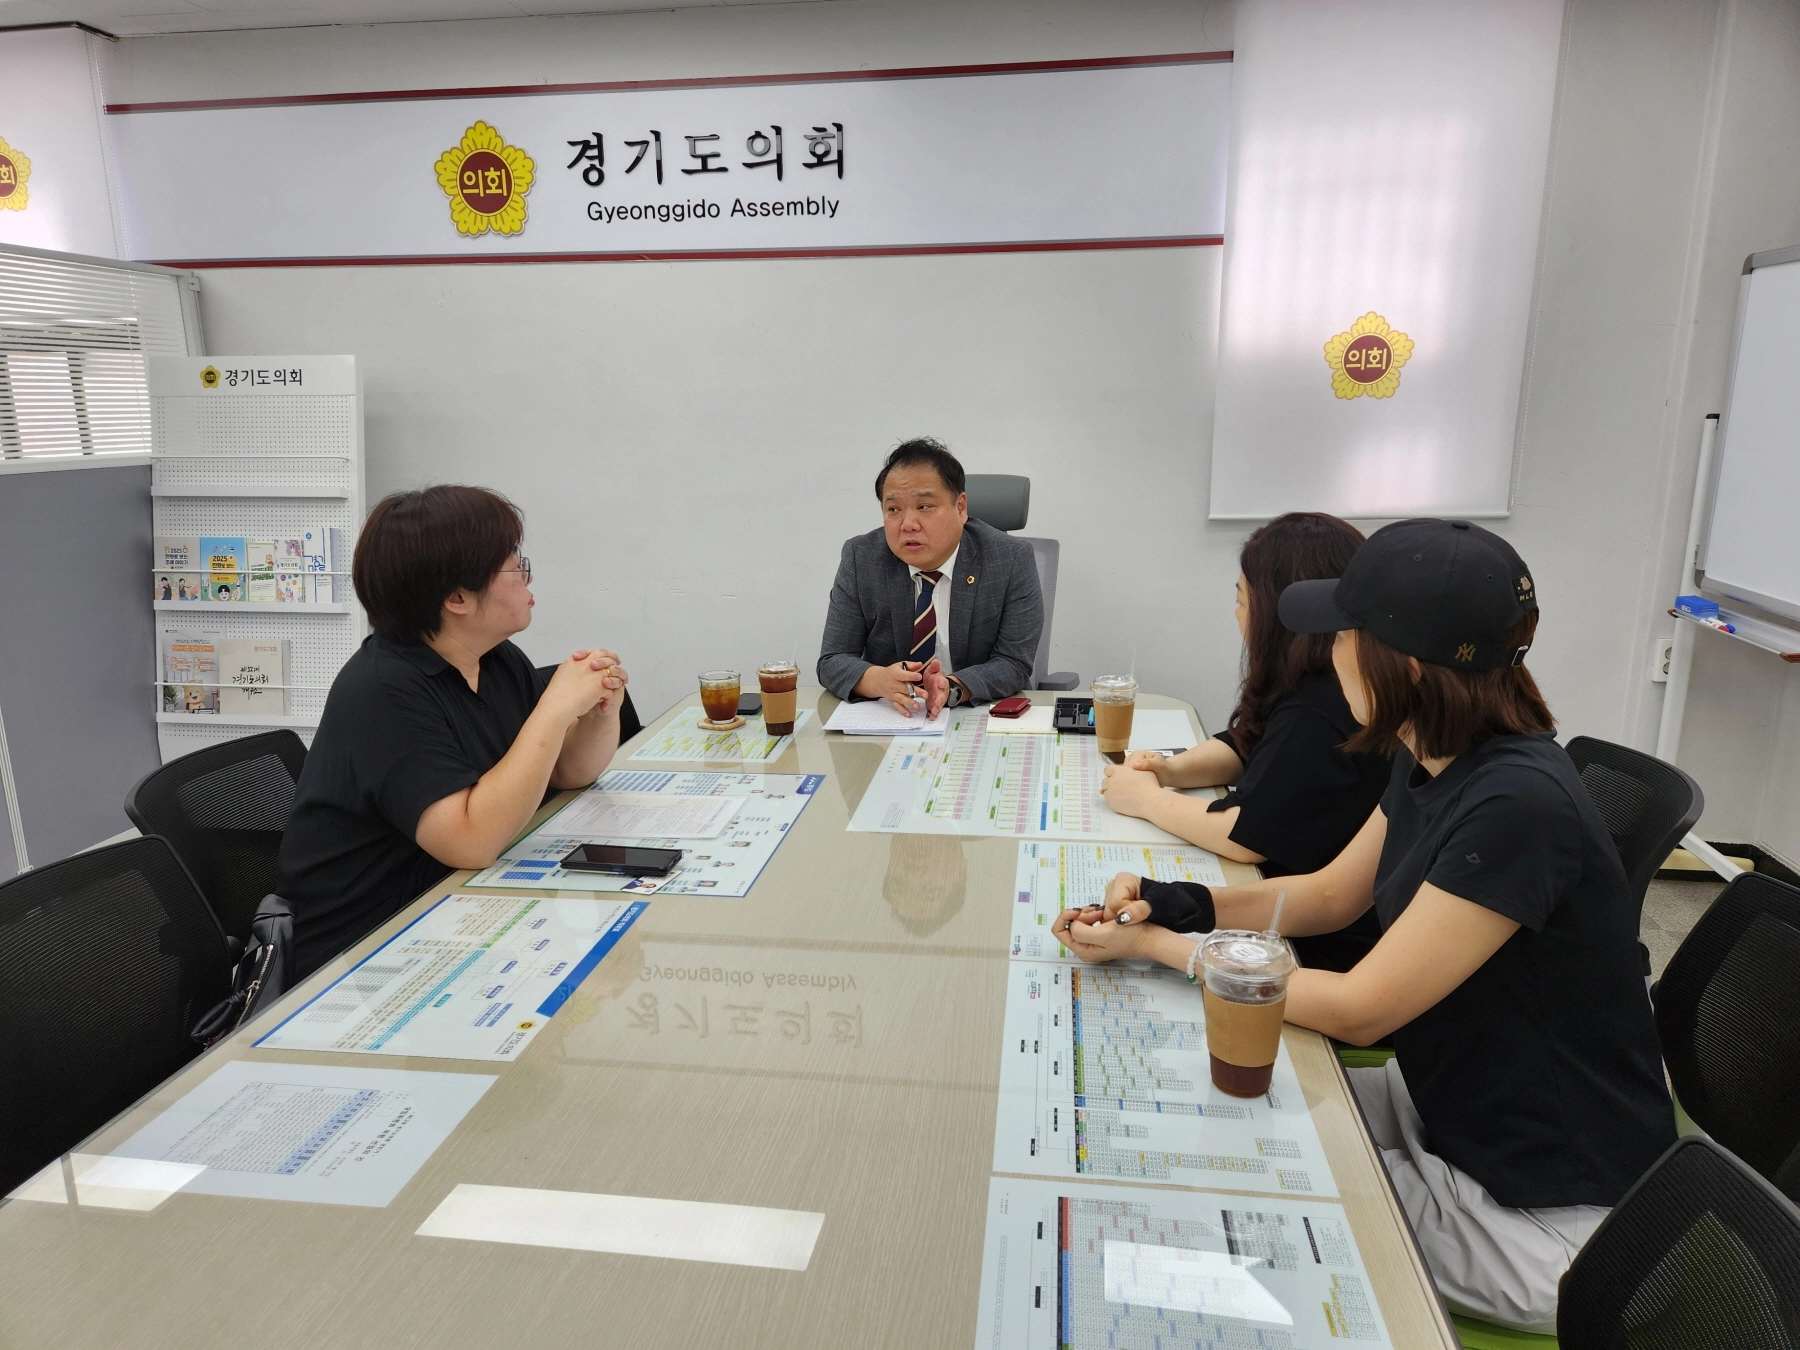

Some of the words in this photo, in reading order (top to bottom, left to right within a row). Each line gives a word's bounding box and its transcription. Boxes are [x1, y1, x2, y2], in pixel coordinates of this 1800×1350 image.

[567, 122, 844, 186] 경기도의회
[462, 167, 507, 198] 의회
[587, 198, 721, 224] Gyeonggido
[730, 195, 840, 219] Assembly
[1345, 347, 1388, 370] 의회
[224, 369, 303, 386] 경기도의회
[1455, 643, 1476, 662] NY
